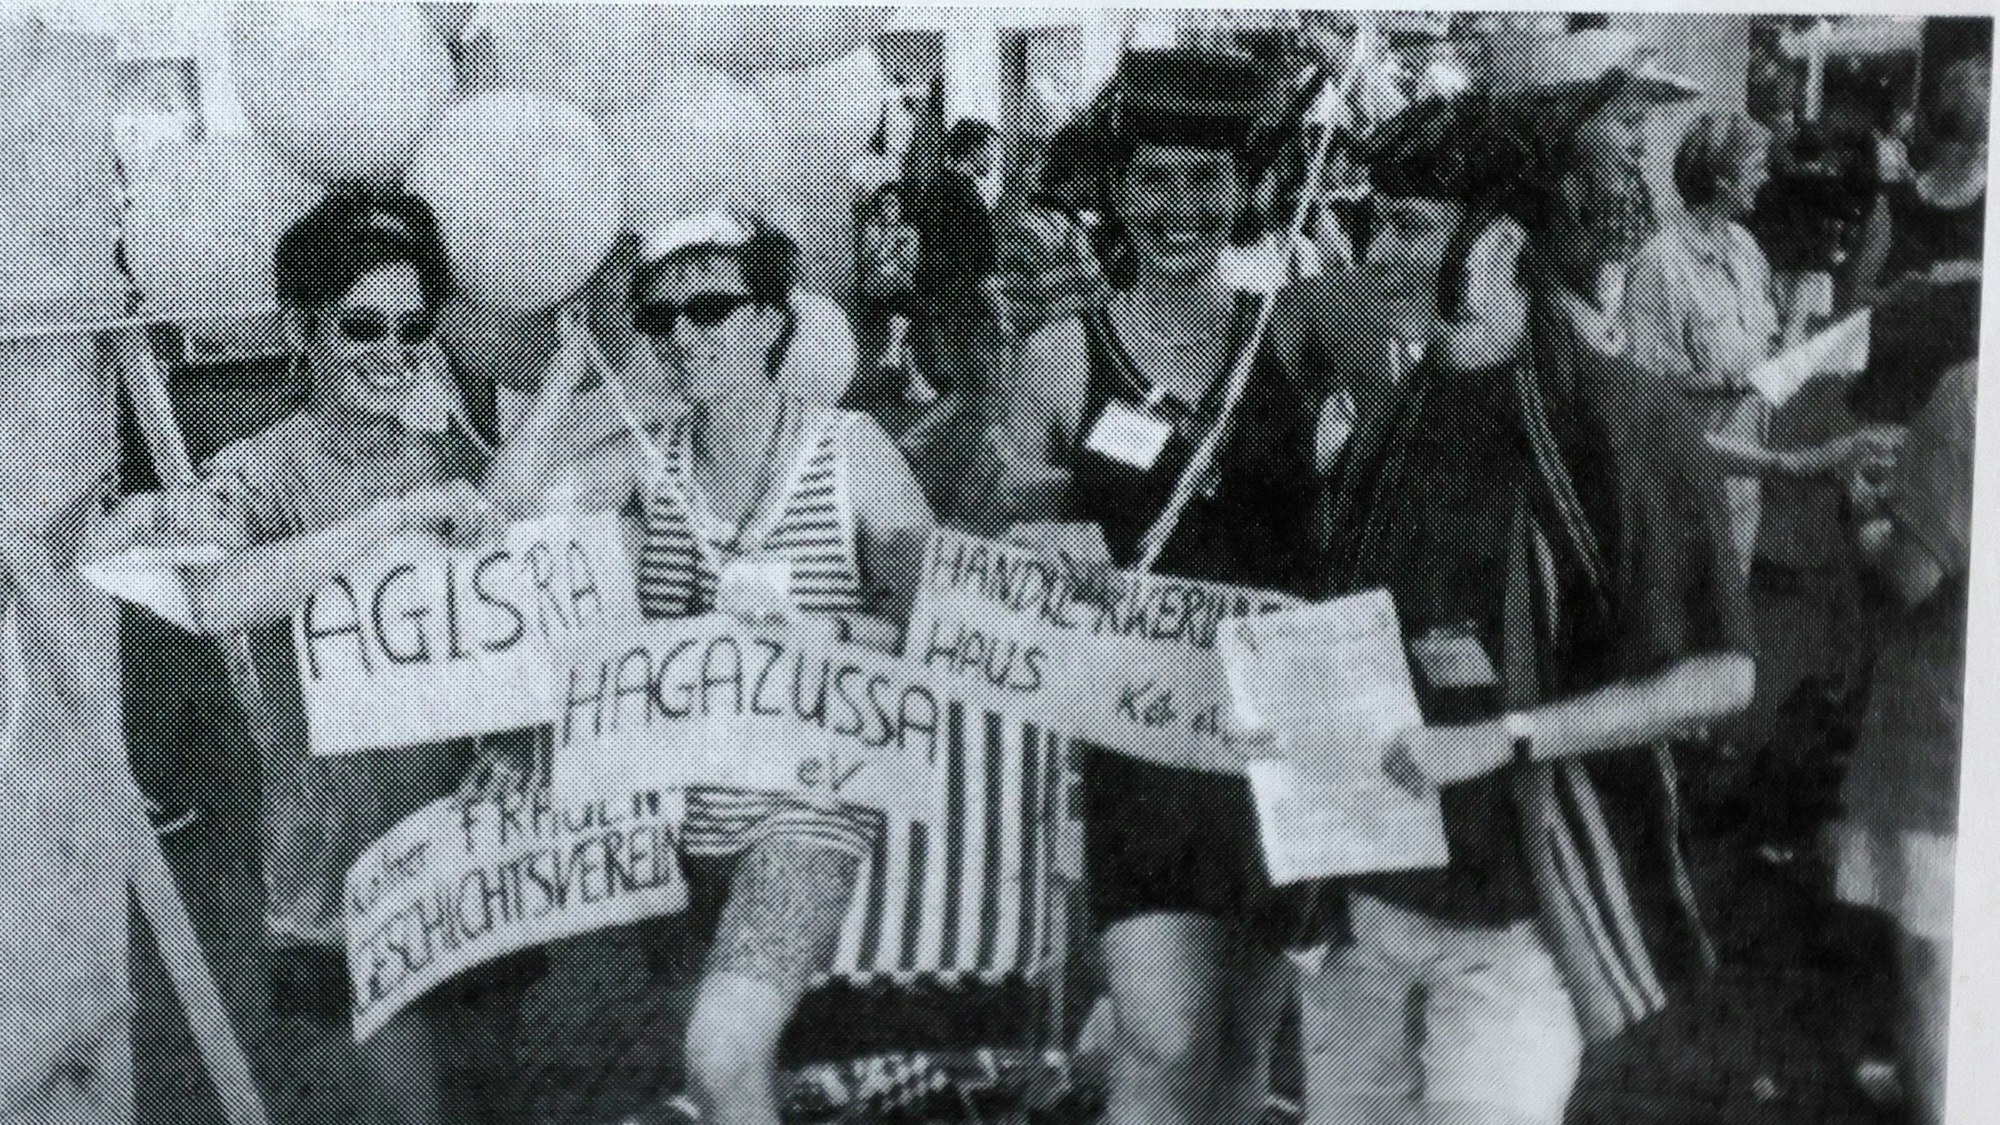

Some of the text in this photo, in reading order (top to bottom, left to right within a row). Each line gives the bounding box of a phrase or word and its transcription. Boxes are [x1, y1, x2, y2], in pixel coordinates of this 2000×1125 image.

[302, 539, 601, 680] AGISRA
[923, 617, 1048, 692] HAUS
[562, 634, 941, 765] HAGAZUSSA
